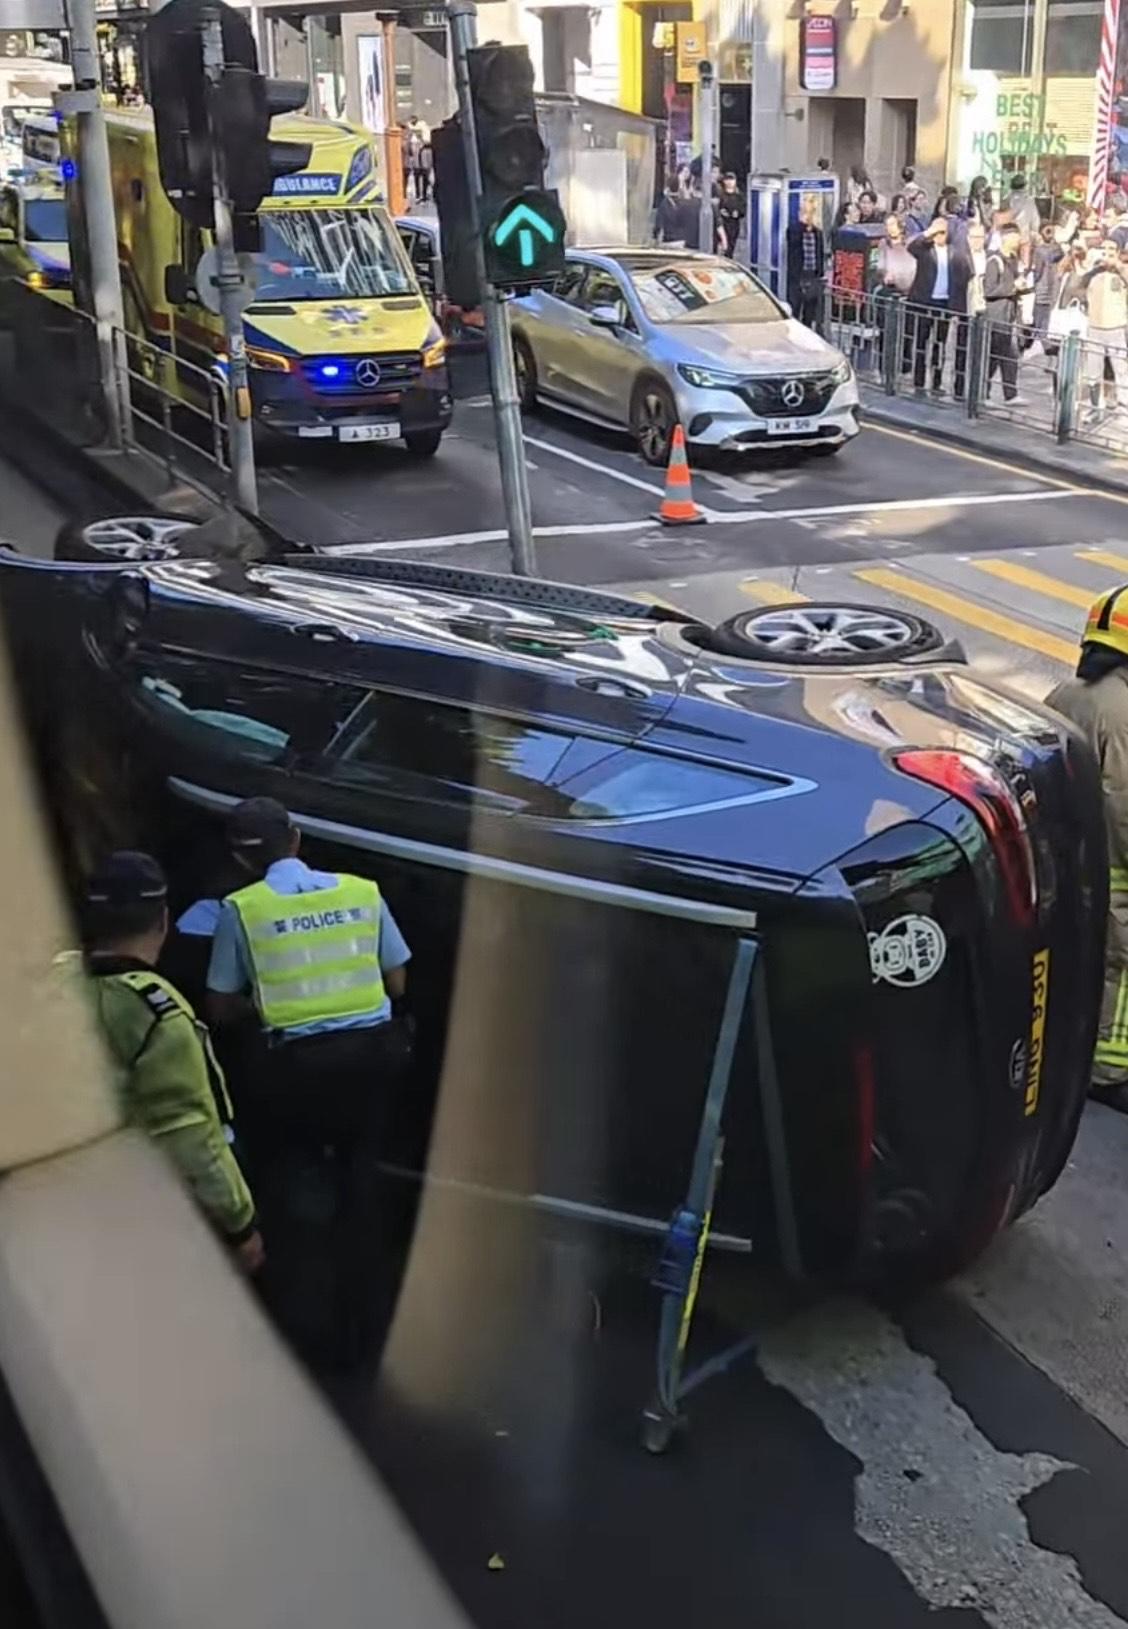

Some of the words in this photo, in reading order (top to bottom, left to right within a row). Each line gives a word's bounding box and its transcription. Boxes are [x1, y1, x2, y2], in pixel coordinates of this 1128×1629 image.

[996, 93, 1045, 119] BEST
[292, 910, 344, 931] POLICE
[913, 929, 931, 969] BABY
